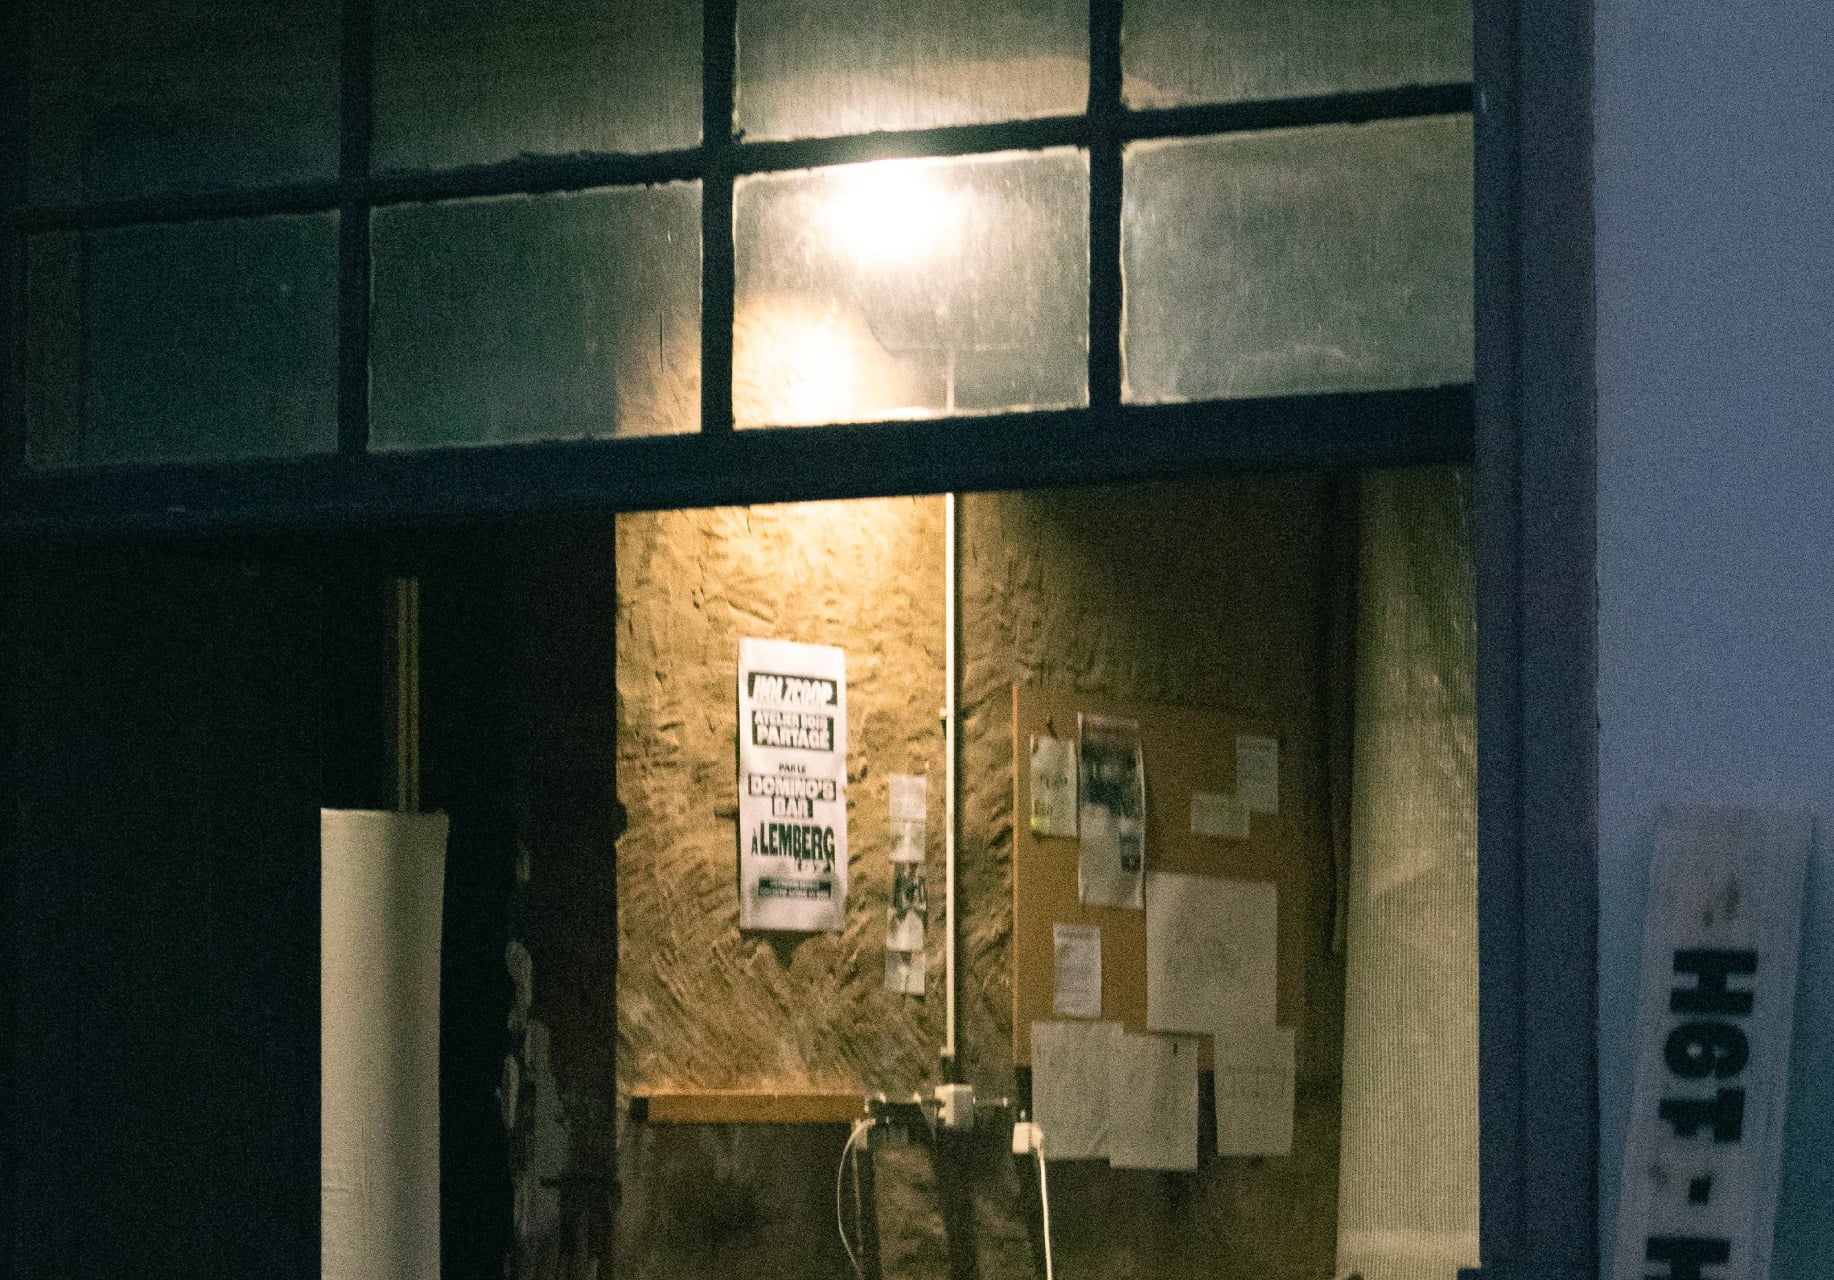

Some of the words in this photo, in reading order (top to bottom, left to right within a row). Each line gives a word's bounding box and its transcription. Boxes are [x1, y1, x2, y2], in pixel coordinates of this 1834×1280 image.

[755, 709, 799, 729] ATELIER
[779, 763, 796, 773] PAR
[797, 765, 806, 774] LE
[751, 774, 835, 801] DOMINO'S
[775, 796, 808, 818] BAR
[760, 821, 835, 864] LEMBERG
[1657, 949, 1758, 1143] 19H
